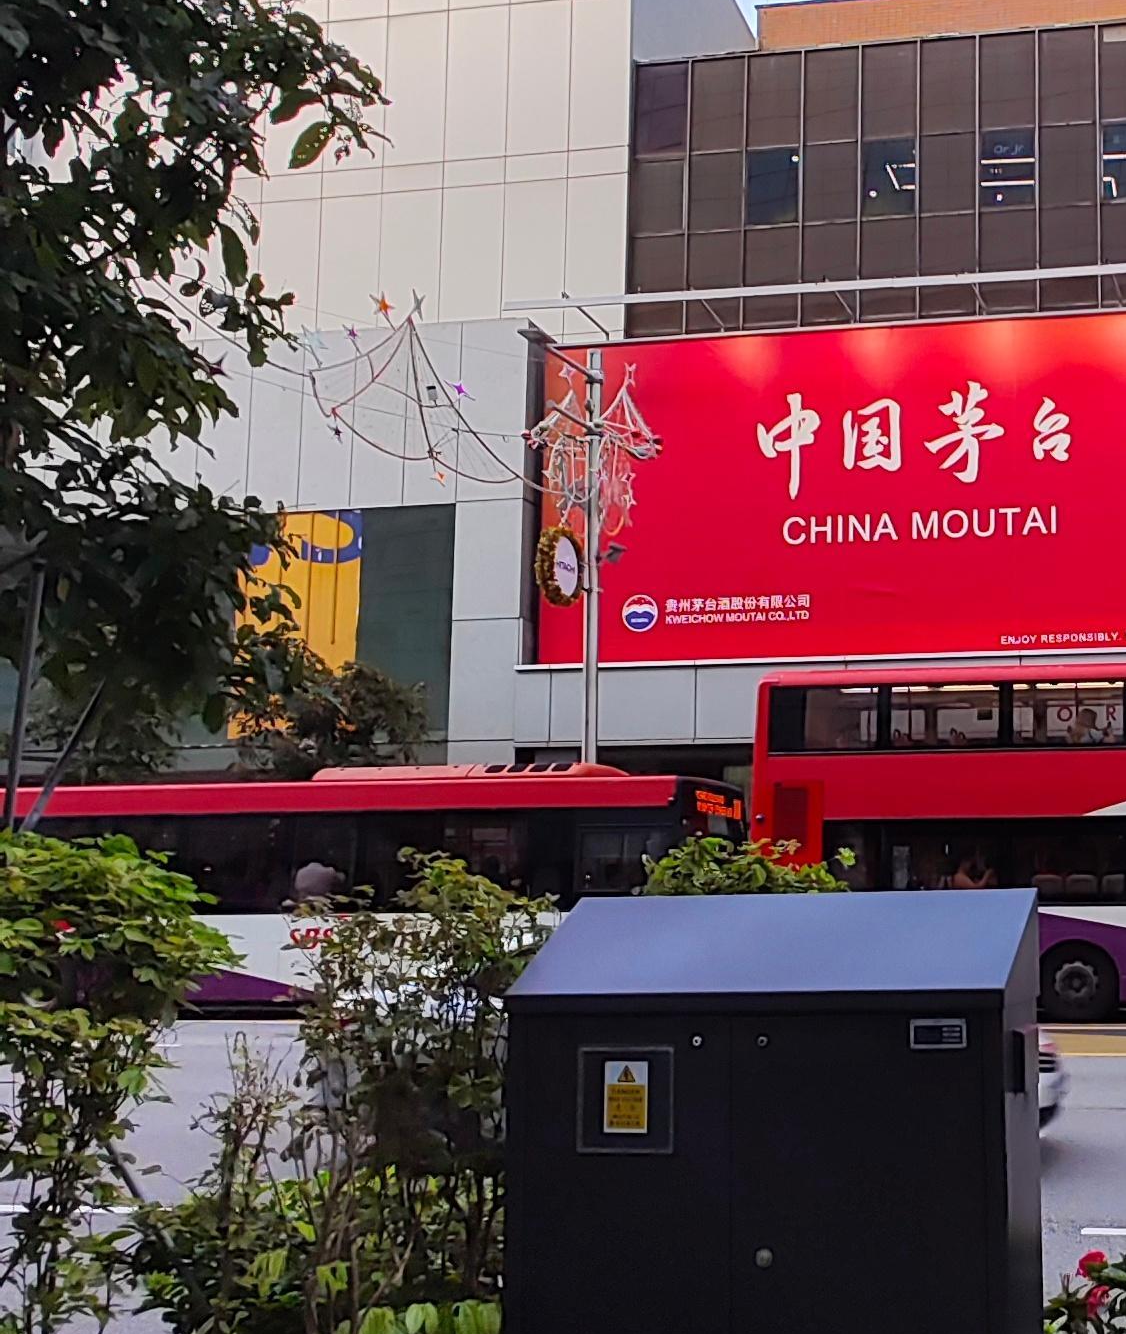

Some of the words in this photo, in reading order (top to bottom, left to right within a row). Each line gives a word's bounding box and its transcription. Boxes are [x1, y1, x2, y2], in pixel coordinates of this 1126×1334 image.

[757, 380, 1072, 500] 中国茅台
[782, 513, 899, 546] CHINA
[911, 505, 1058, 540] MOUTAI
[665, 614, 724, 624] KWEICHOW
[726, 612, 766, 623] MOUTAI
[1001, 635, 1037, 645] ENJOY
